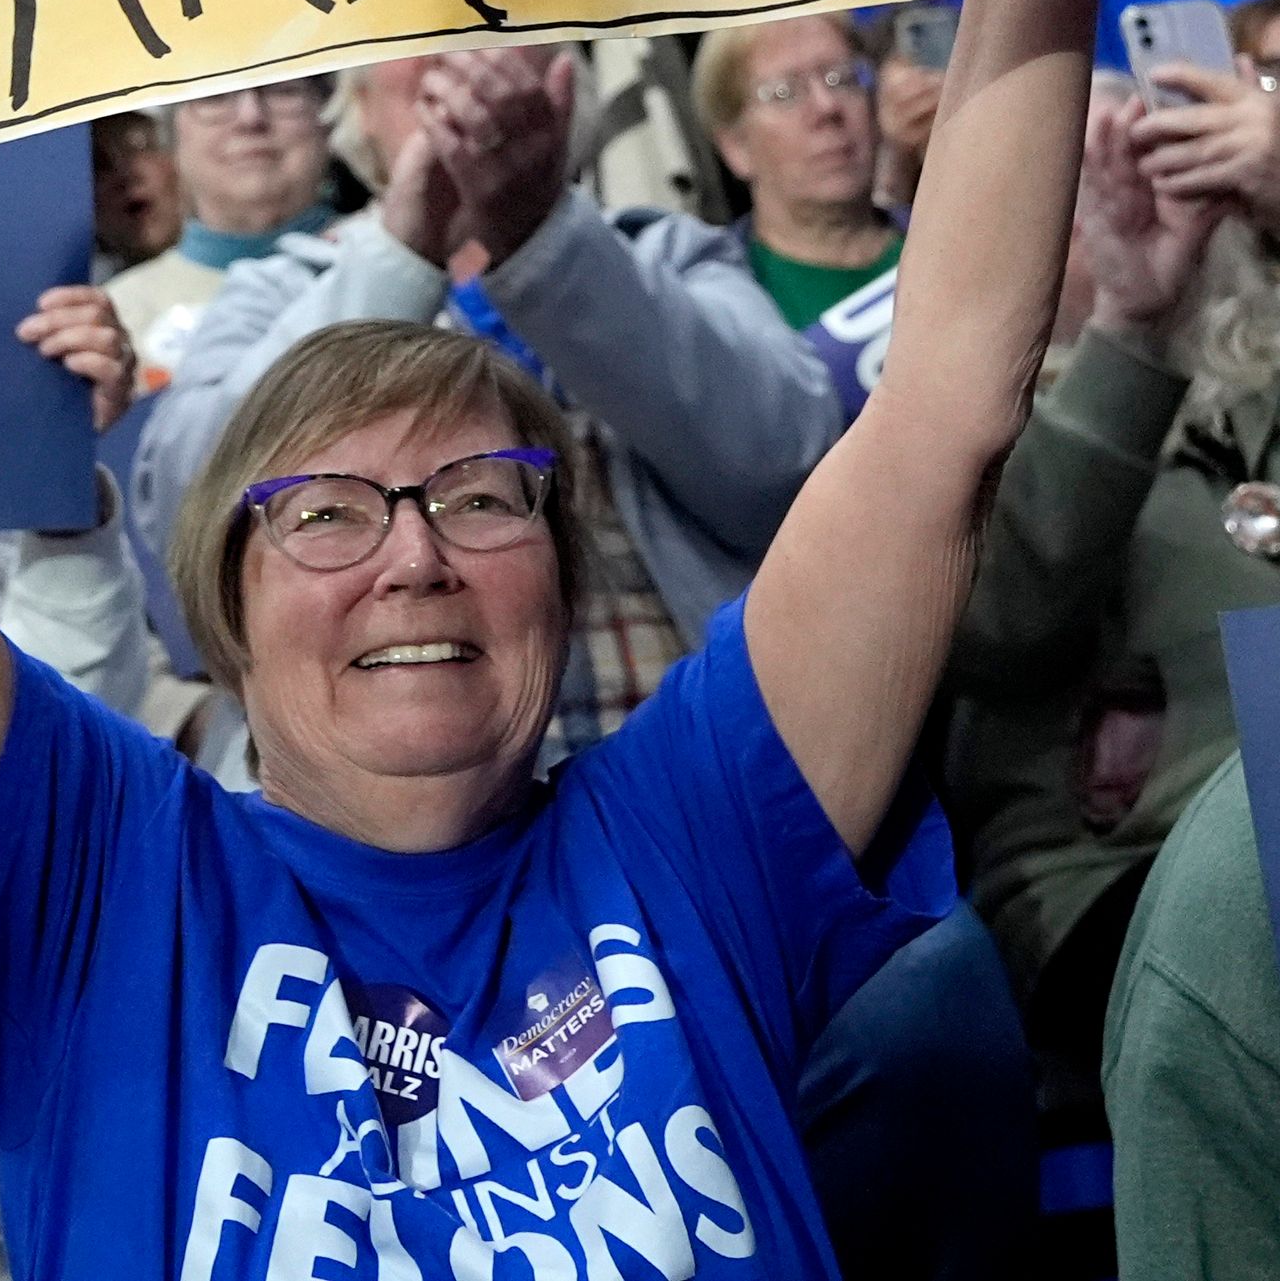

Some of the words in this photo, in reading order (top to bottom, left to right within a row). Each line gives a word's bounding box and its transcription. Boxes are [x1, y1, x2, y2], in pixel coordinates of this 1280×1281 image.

[353, 1014, 447, 1079] ARRIS
[500, 976, 591, 1055] Democracy
[510, 994, 606, 1076] MATTERS
